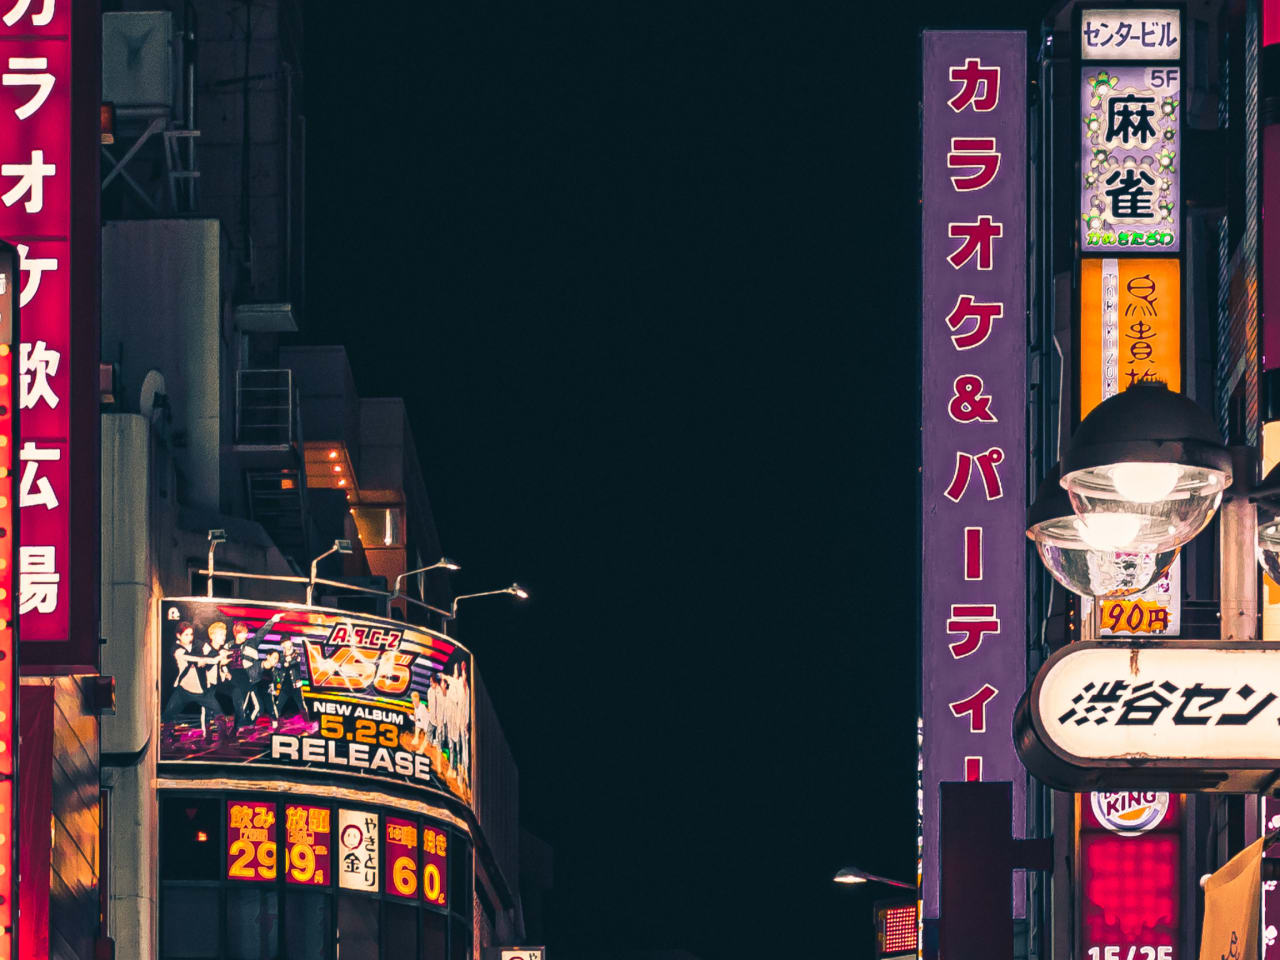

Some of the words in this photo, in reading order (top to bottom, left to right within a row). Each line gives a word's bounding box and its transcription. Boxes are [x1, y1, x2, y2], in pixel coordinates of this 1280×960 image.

[1083, 20, 1178, 48] センタービル
[1150, 69, 1179, 88] 5F
[1104, 94, 1157, 220] 麻雀
[312, 701, 351, 717] NEW
[354, 706, 404, 726] ALBUM
[320, 714, 399, 747] 5.23
[271, 735, 431, 781] RELEASE
[343, 852, 362, 874] 金
[363, 817, 378, 888] やきとり
